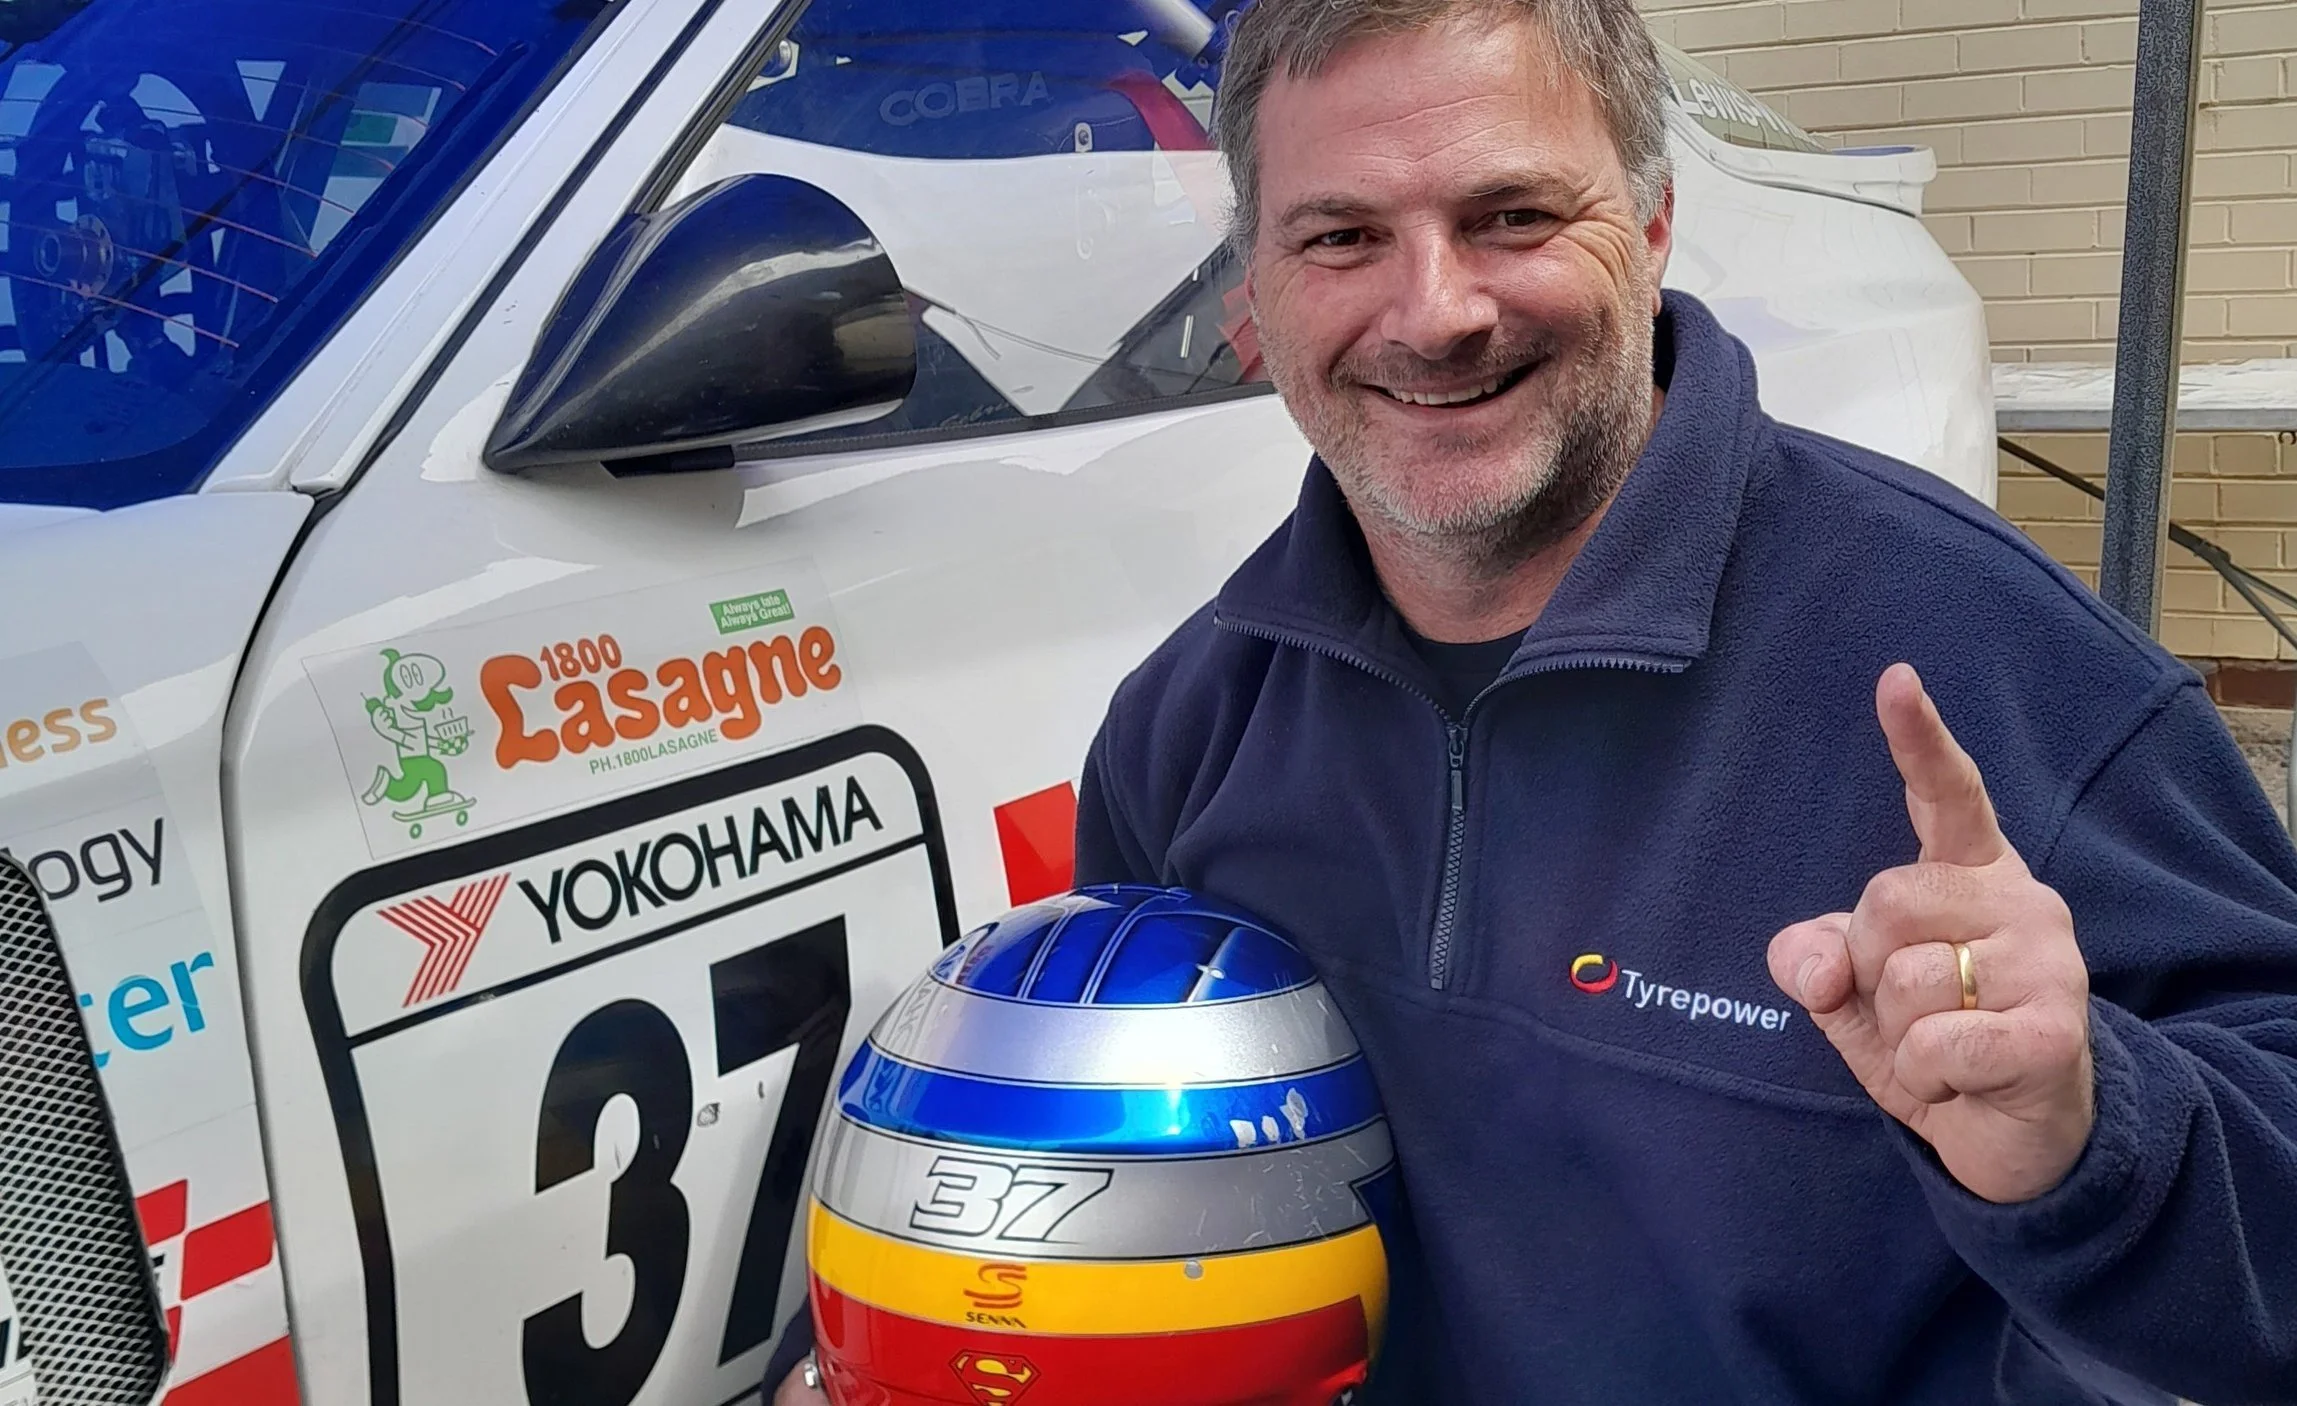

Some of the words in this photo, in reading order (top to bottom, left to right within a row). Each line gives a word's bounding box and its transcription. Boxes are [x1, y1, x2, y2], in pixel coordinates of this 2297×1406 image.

[880, 71, 1053, 126] COBRA
[721, 612, 758, 628] Always
[722, 600, 760, 615] Always
[540, 633, 623, 681] 1800
[480, 625, 842, 769] Lasagne
[589, 728, 719, 775] PH.1800LASAGNE
[0, 818, 163, 902] ogy
[519, 775, 884, 944] YOKOHAMA
[79, 951, 214, 1068] er
[1621, 969, 1792, 1032] Tyrepower
[522, 913, 852, 1406] 37
[909, 1155, 1115, 1244] 37
[965, 1311, 1026, 1329] SENNA
